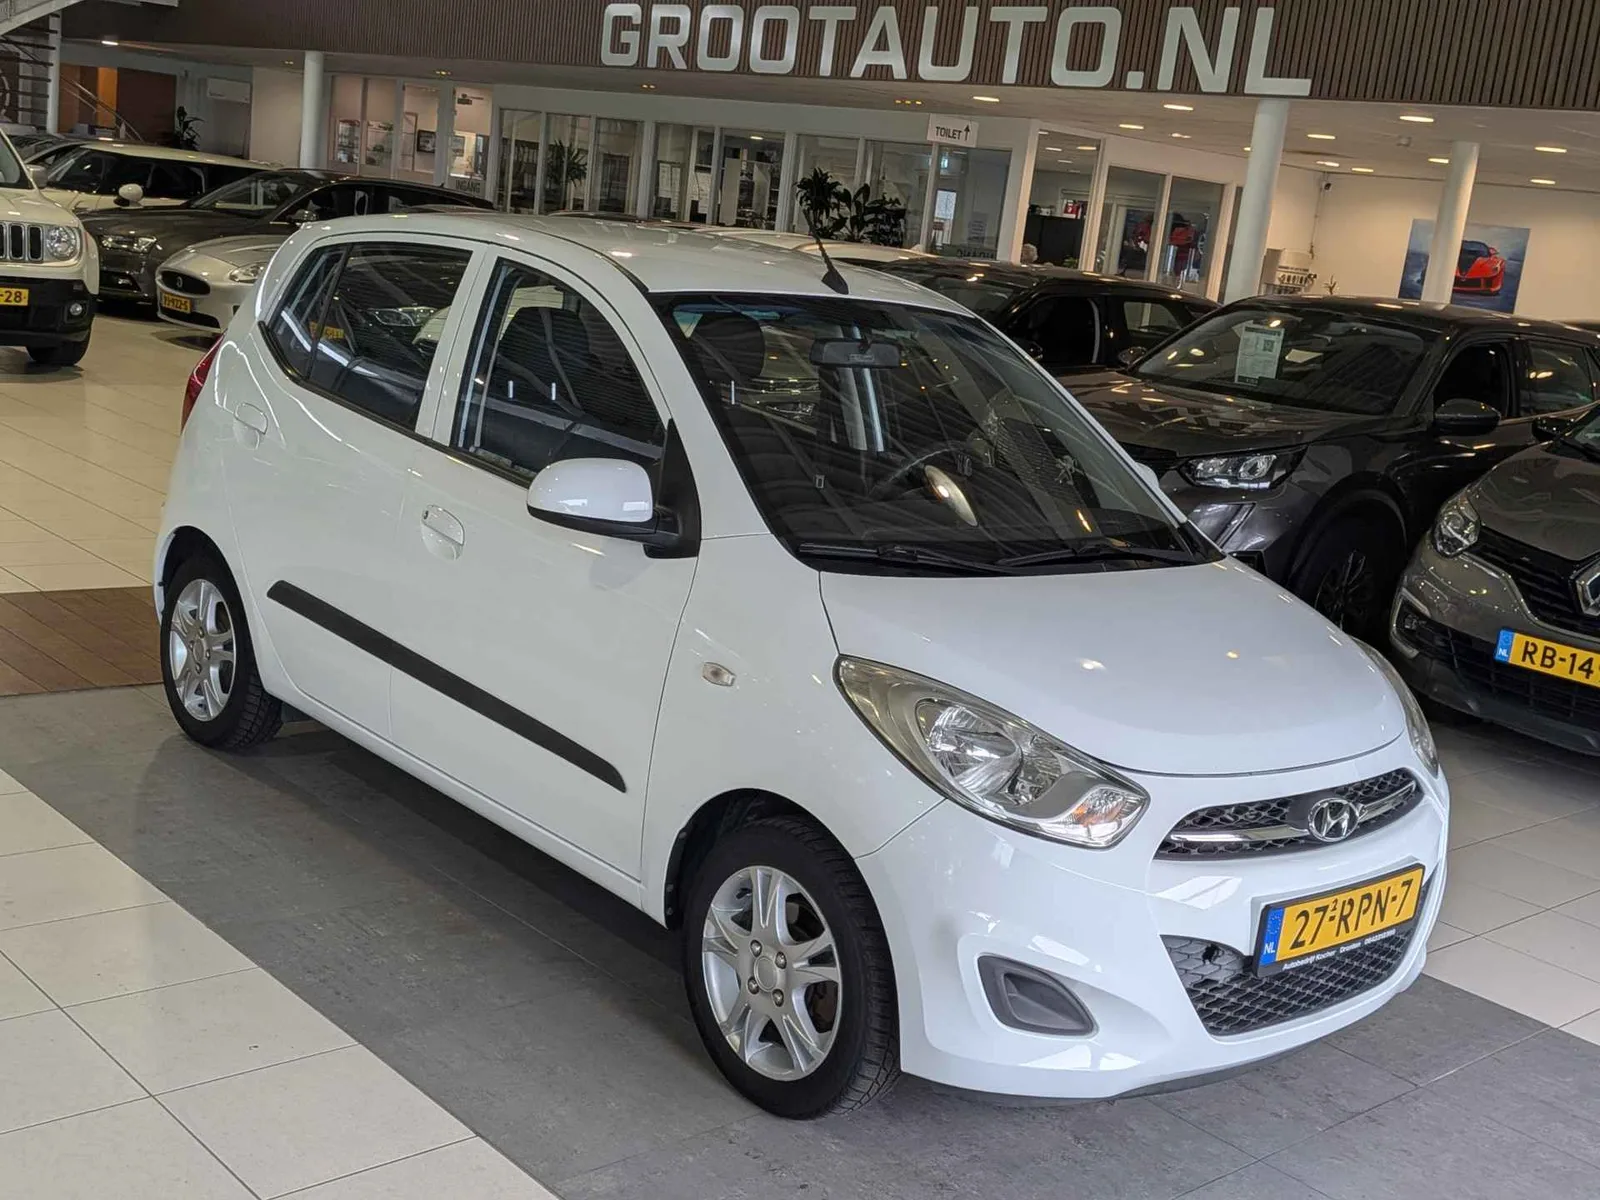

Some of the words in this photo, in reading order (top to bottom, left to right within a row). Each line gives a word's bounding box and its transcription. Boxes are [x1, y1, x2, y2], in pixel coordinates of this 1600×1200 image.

[600, 3, 1312, 96] GROOTAUTO.NL
[935, 126, 962, 140] TOILET
[1498, 647, 1509, 658] NL
[1289, 878, 1414, 951] 27-RPN-7
[1263, 941, 1276, 954] NL
